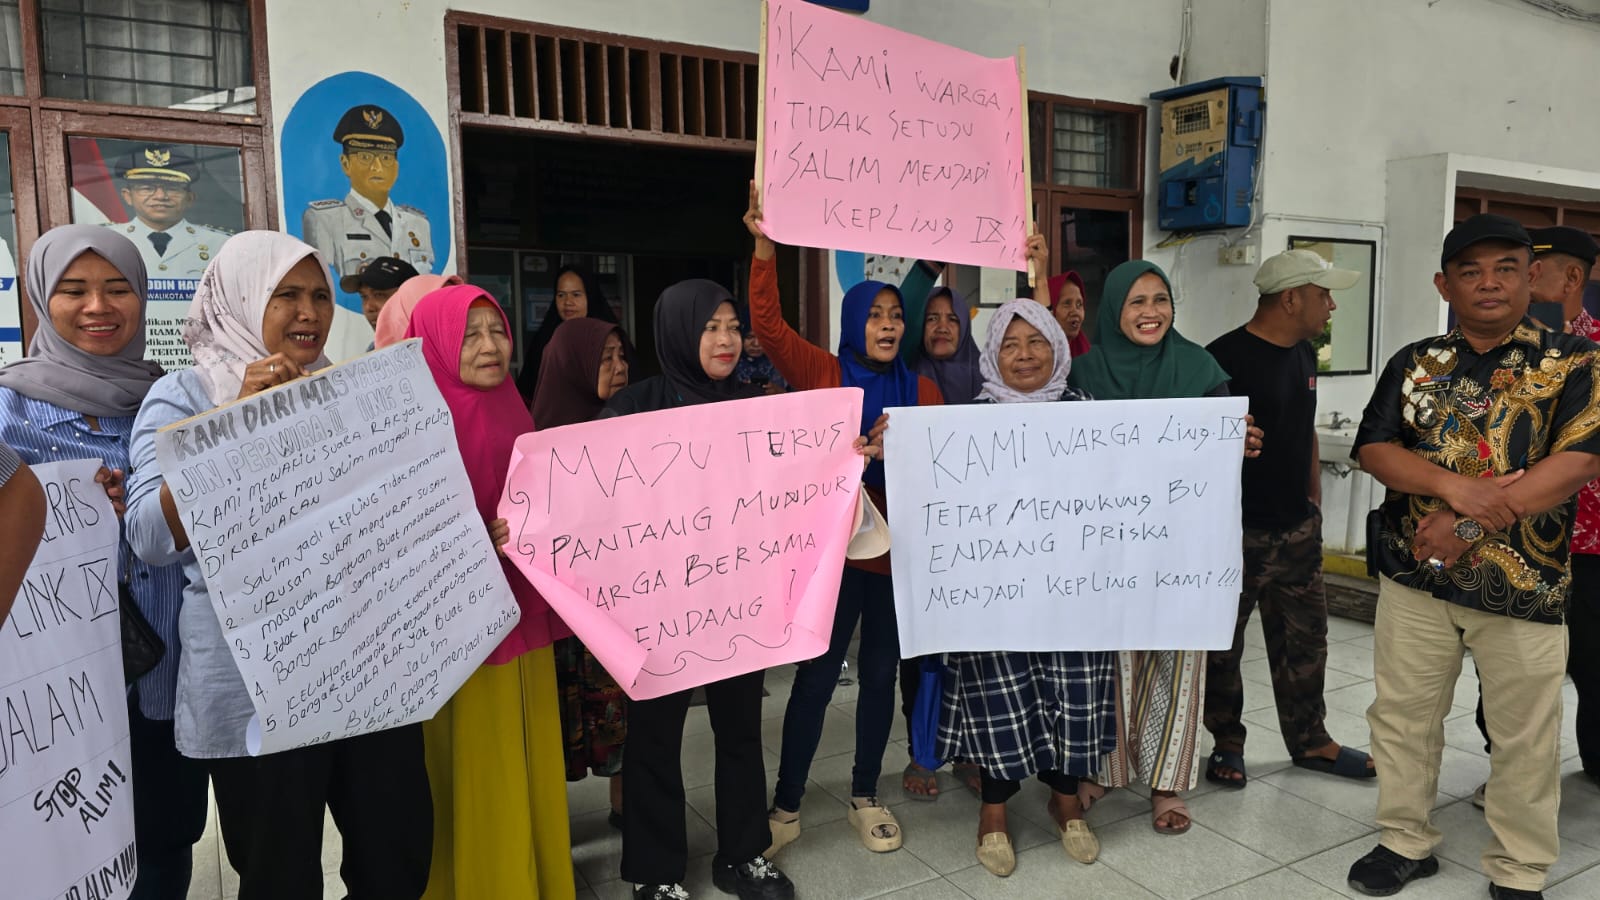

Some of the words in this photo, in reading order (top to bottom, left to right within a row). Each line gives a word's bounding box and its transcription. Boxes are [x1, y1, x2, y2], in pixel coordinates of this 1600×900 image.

[915, 70, 1001, 111] WARGA
[786, 101, 872, 136] TIDAK
[888, 109, 974, 141] SETUJU
[782, 141, 881, 189] SALIM
[399, 377, 415, 405] 9
[173, 411, 239, 461] KAMI
[242, 388, 297, 435] DARI
[1045, 422, 1141, 457] WARGA
[1217, 415, 1245, 441] IX
[545, 440, 712, 515] MAJU
[737, 421, 846, 463] TERUS
[550, 506, 712, 576] PANTANG
[731, 474, 851, 525] MUNDUR
[921, 501, 999, 536] TETAP
[1168, 479, 1209, 504] BU
[586, 568, 668, 612] ARGA
[684, 532, 817, 588] BERSAMA
[929, 532, 1056, 574] ENDANG
[78, 557, 118, 622] IX
[219, 590, 236, 609] 1.
[635, 595, 763, 651] ENDANG
[34, 767, 87, 822] STOP
[79, 760, 126, 834] ALIM!
